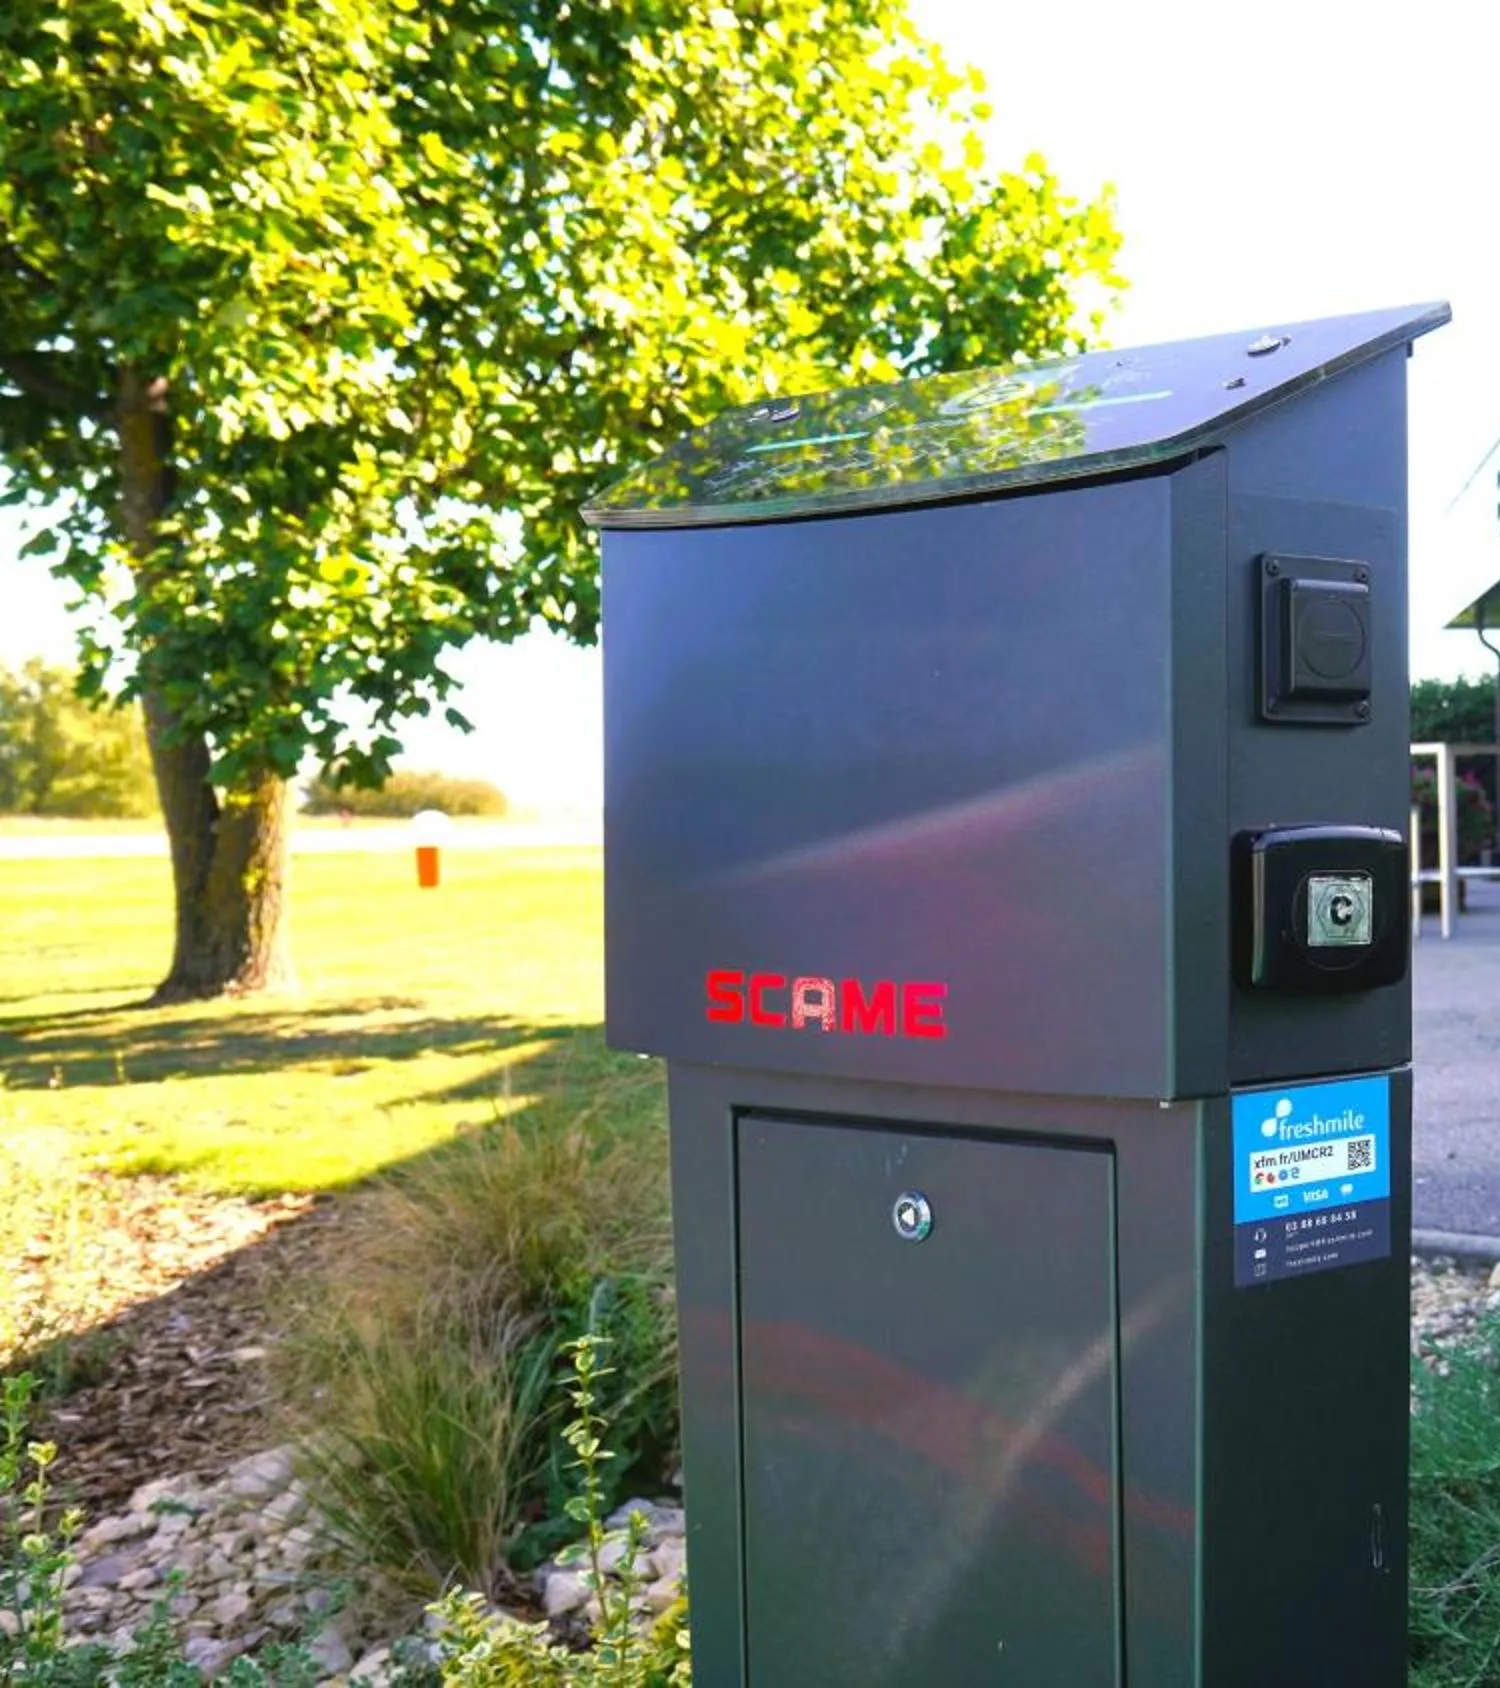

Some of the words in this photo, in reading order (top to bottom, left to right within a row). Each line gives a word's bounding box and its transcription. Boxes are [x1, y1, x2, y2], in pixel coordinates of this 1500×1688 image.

[706, 968, 947, 1039] SCAME
[1279, 1110, 1365, 1141] freshmile
[1254, 1145, 1335, 1169] xfmfr/UMCR2
[1303, 1187, 1329, 1203] VISA
